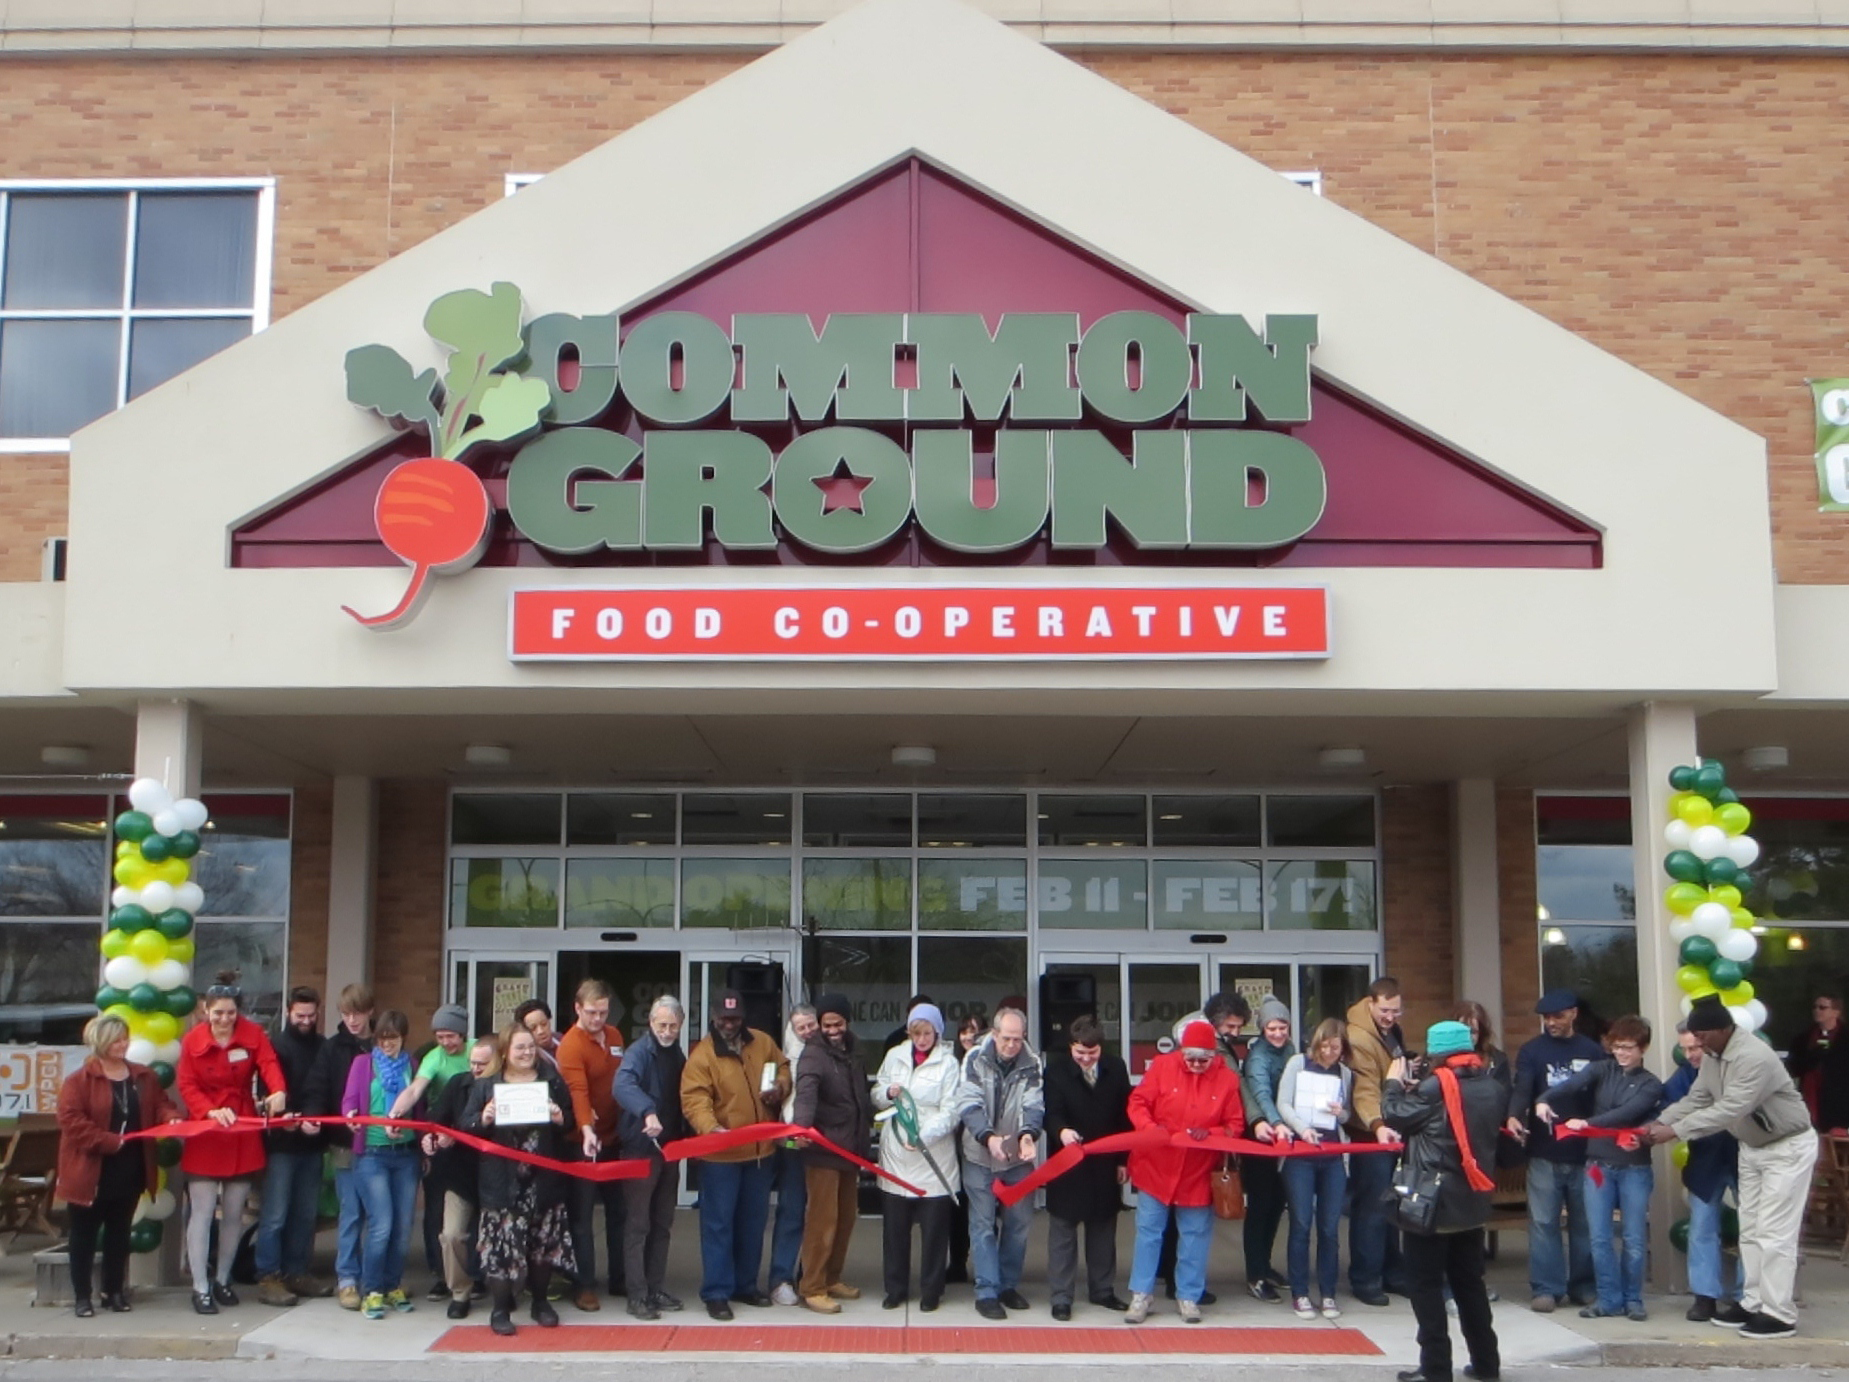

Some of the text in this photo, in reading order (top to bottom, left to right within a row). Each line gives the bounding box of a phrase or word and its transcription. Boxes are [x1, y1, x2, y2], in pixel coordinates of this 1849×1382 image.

[527, 310, 1320, 425] COMMON
[506, 426, 1328, 555] GROUND
[551, 606, 1287, 640] FOOD CO-OPERATIVE
[469, 873, 676, 911] GRAND
[960, 876, 1072, 912] FEB
[1085, 876, 1120, 912] 11
[1166, 877, 1278, 912] FEB
[1290, 877, 1354, 912] 17!
